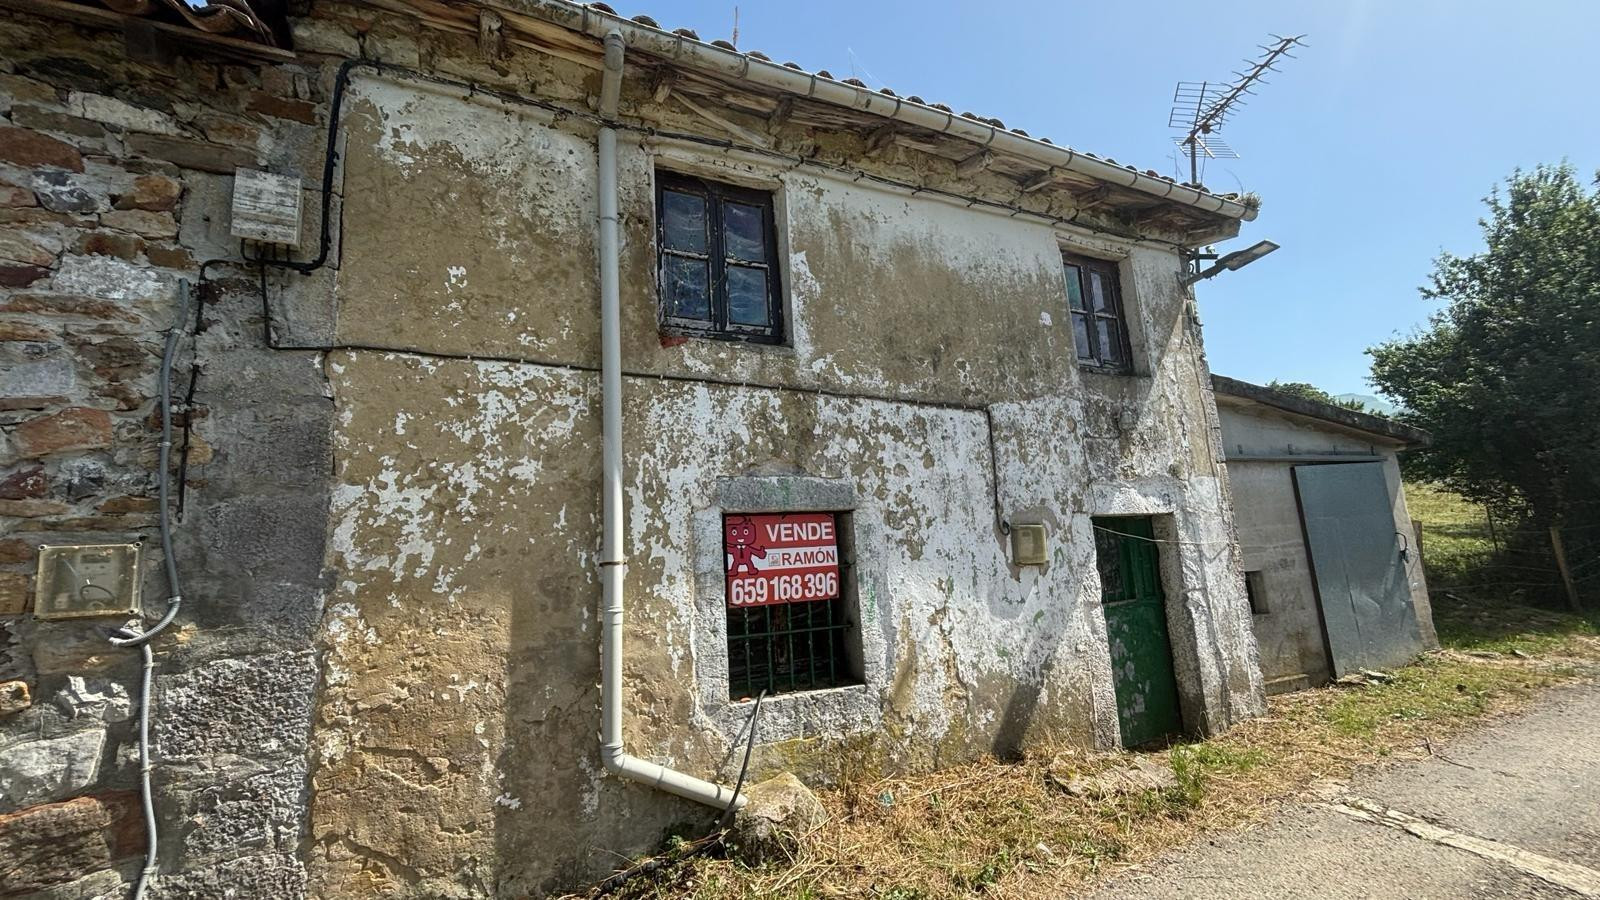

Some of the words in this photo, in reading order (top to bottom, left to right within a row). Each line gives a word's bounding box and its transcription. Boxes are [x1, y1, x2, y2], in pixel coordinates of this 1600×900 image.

[765, 522, 834, 542] VENDE
[781, 547, 836, 566] RAMÓN
[731, 577, 768, 605] 659
[769, 574, 802, 601] 168
[804, 572, 837, 598] 396
